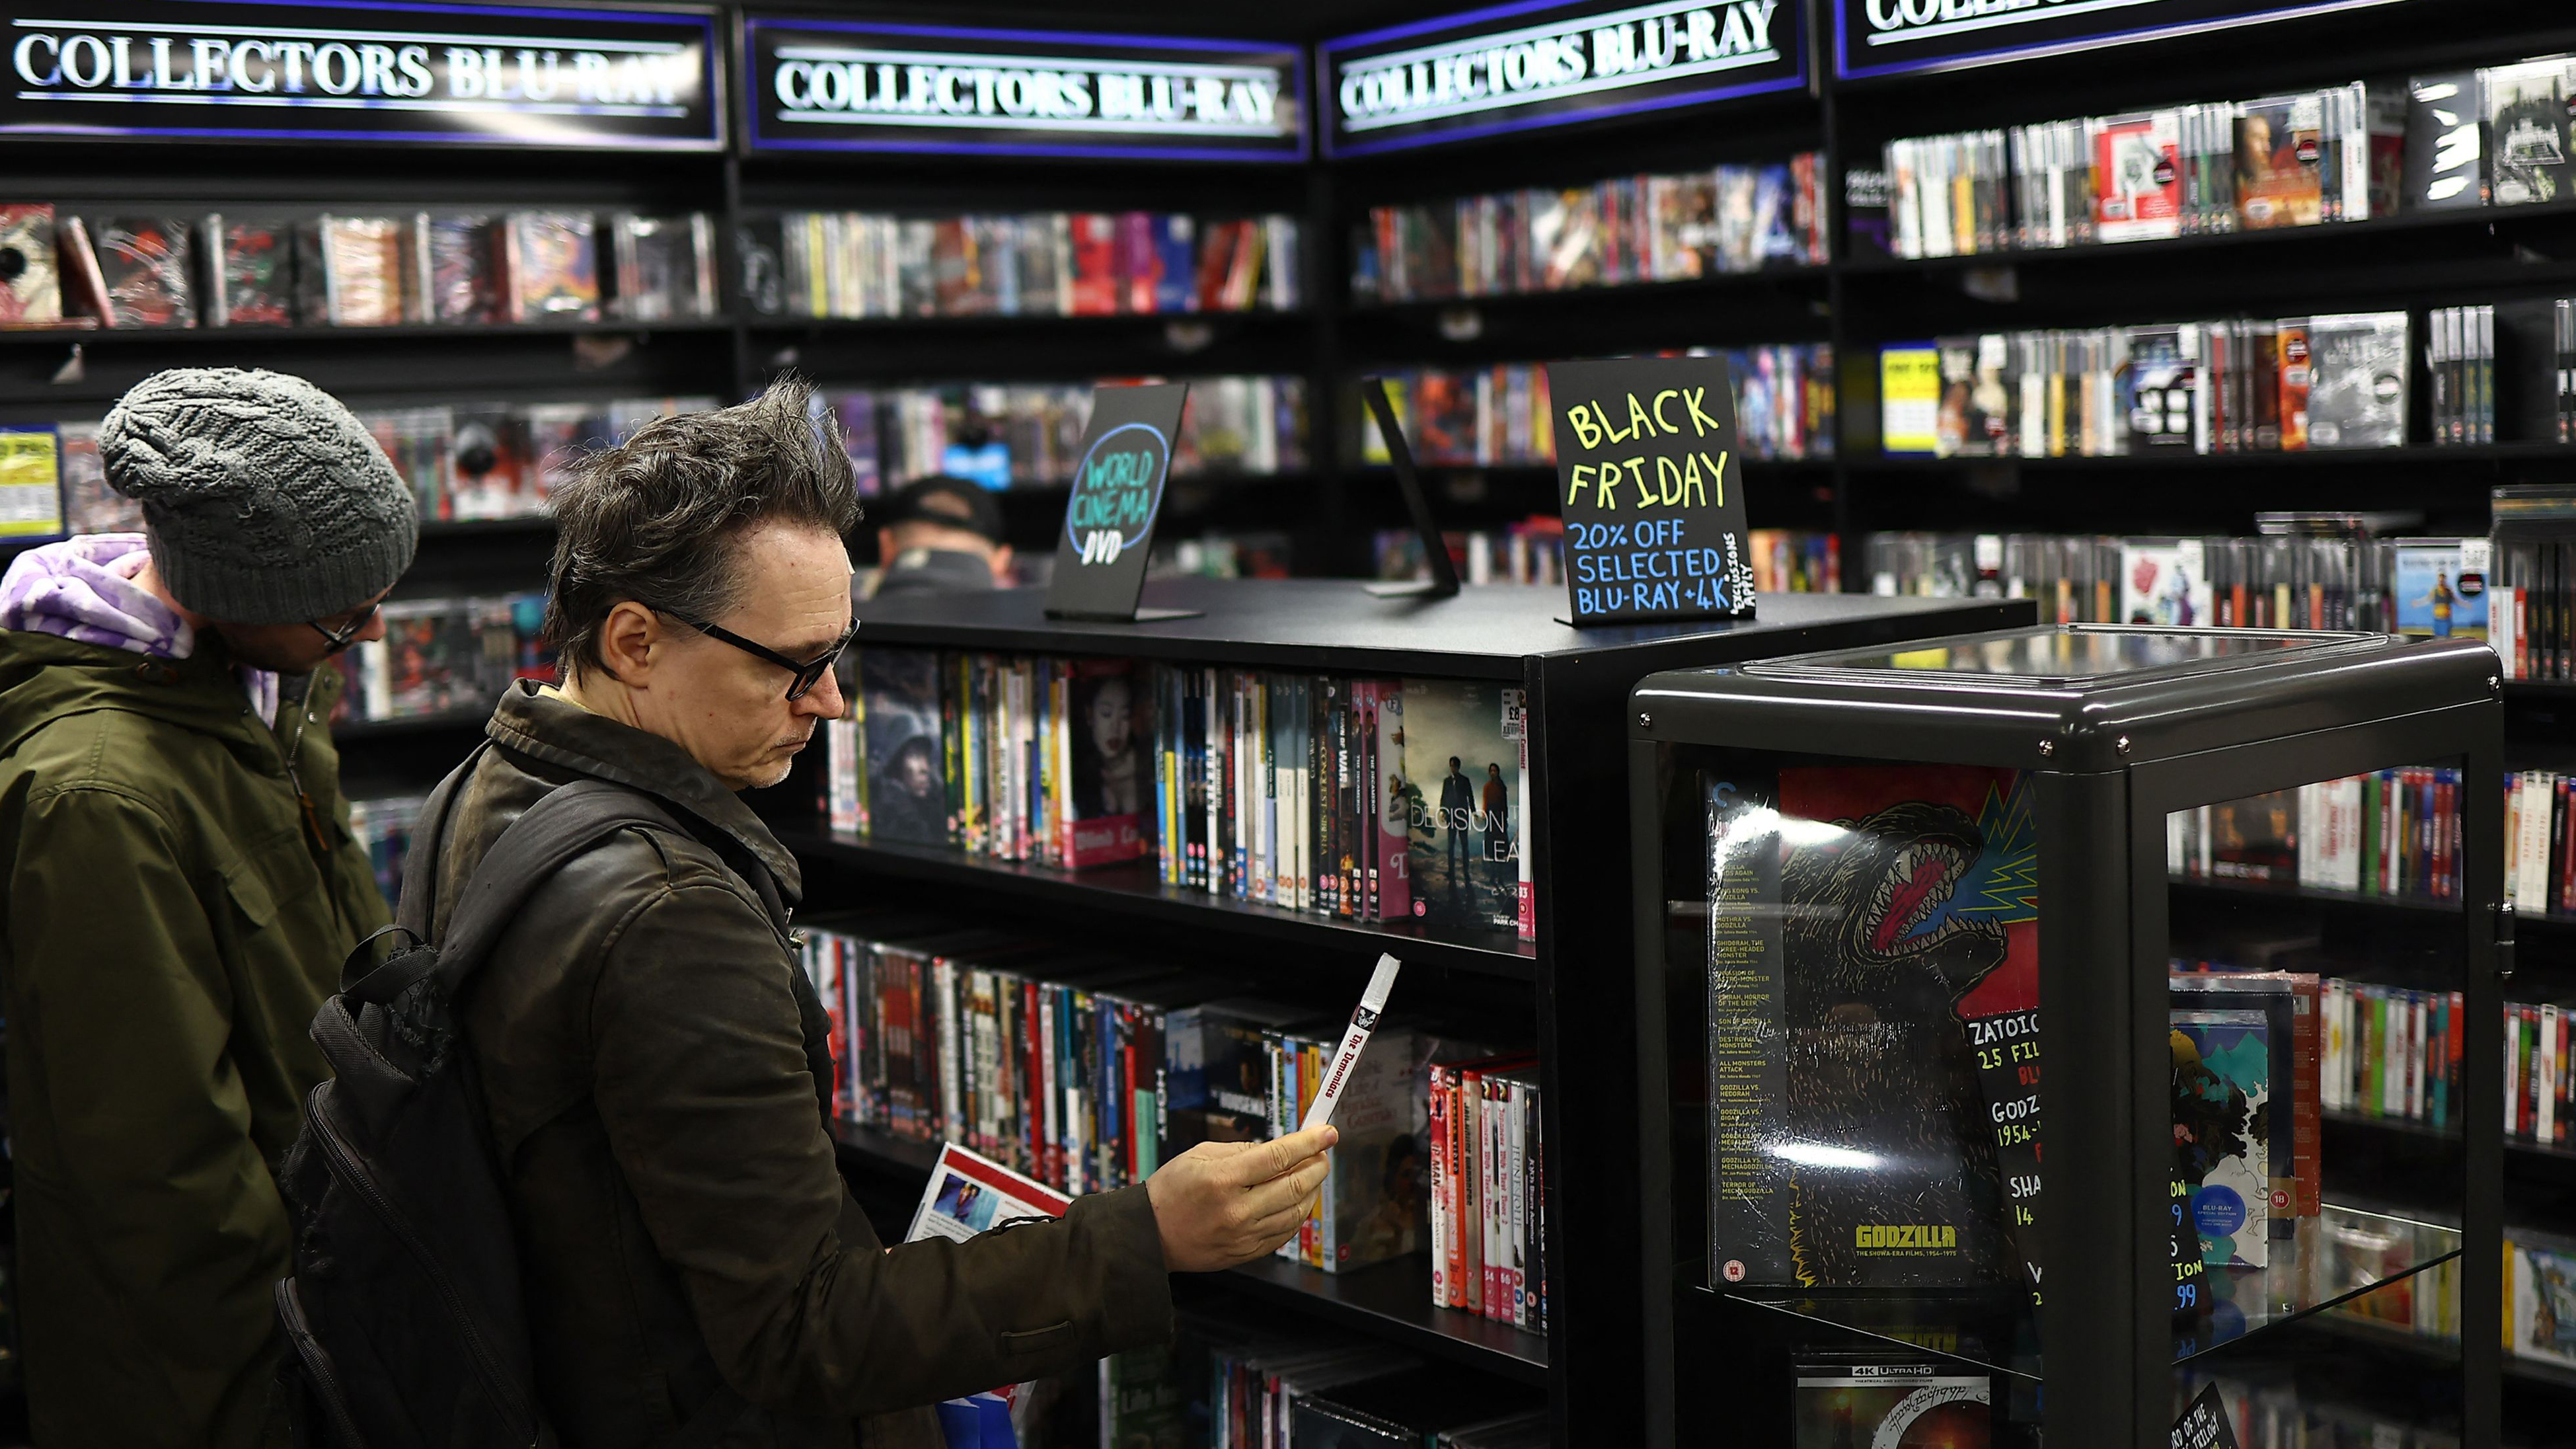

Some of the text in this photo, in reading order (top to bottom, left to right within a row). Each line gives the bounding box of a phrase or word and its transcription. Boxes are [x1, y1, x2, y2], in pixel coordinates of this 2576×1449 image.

[13, 33, 685, 104] COLLECTORS BLU-RAY
[1340, 0, 1779, 122] COLLECTORS BLU-RAY
[775, 61, 1279, 125] COLLECTORS BLU-RAY
[1567, 386, 1720, 450] BLACK
[1087, 450, 1154, 490] WORLD
[1567, 450, 1728, 510] FRIDAY
[1073, 487, 1149, 528] CINEMA
[1080, 529, 1123, 567] DVD
[1568, 518, 1685, 551] 20% OFF
[1577, 547, 1720, 584] SELECTED
[1577, 579, 1681, 615] BLU-RAY
[1740, 563, 1756, 607] APPLY
[1339, 750, 1348, 783] WAR
[1410, 797, 1505, 834] DECISION
[1483, 840, 1519, 863] LEA
[1968, 1013, 2040, 1045] ZATOIC
[1325, 1034, 1363, 1099] The Demoniacs
[1977, 1041, 2040, 1070] 25 FIL
[1992, 1095, 2040, 1123] GODZ
[1431, 1144, 1441, 1187] IP MAN
[2010, 1175, 2042, 1198] SHA
[2274, 1194, 2285, 1204] 18
[2016, 1204, 2034, 1226] 14
[1856, 1225, 1956, 1248] GODZILLA
[1729, 1267, 1739, 1275] 12
[1854, 1366, 1932, 1376] 4K ULTRA HD
[2183, 1416, 2193, 1438] OF
[2194, 1402, 2207, 1428] THE
